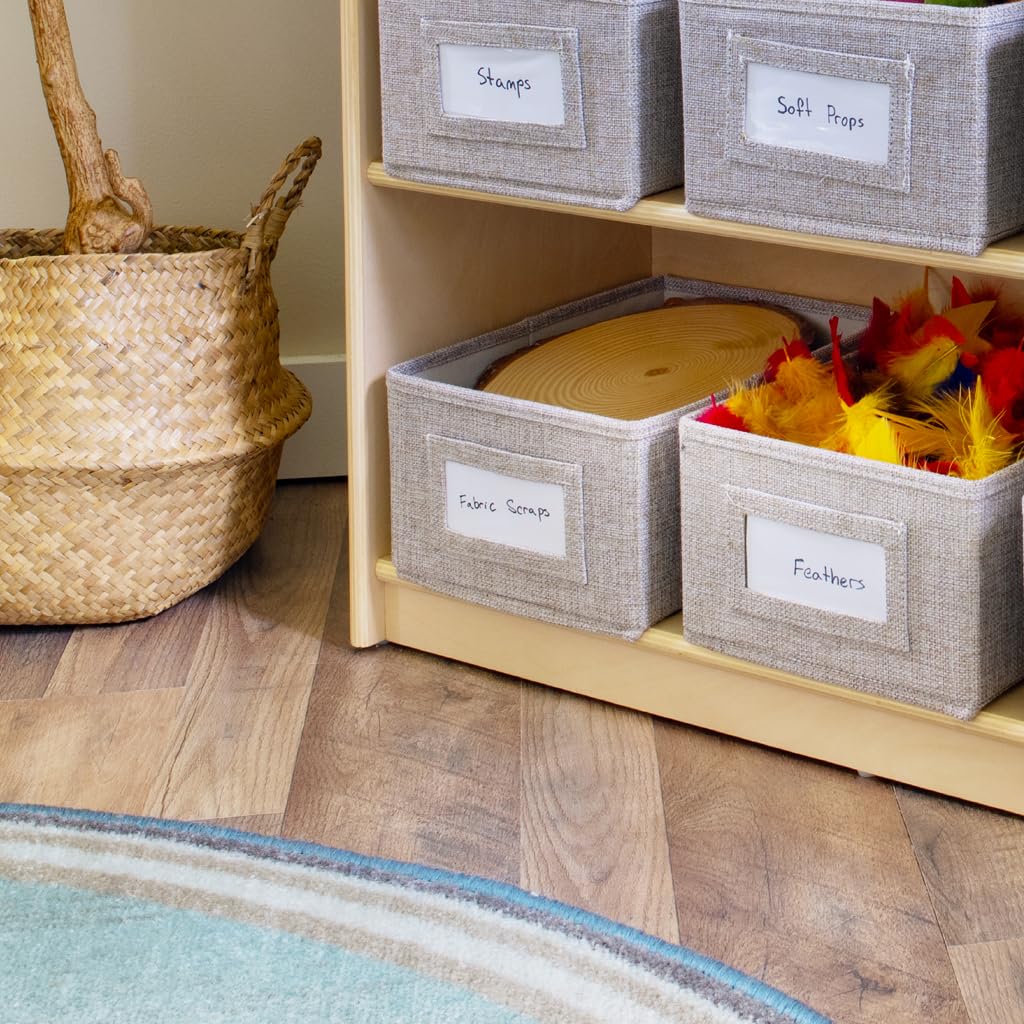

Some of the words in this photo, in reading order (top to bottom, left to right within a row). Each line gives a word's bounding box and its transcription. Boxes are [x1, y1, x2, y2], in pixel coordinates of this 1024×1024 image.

[477, 66, 532, 99] Stamps
[777, 95, 813, 118] Soft
[827, 103, 865, 131] Props
[459, 494, 497, 513] Fabric
[506, 498, 551, 523] Scraps
[793, 558, 866, 591] Feathers
